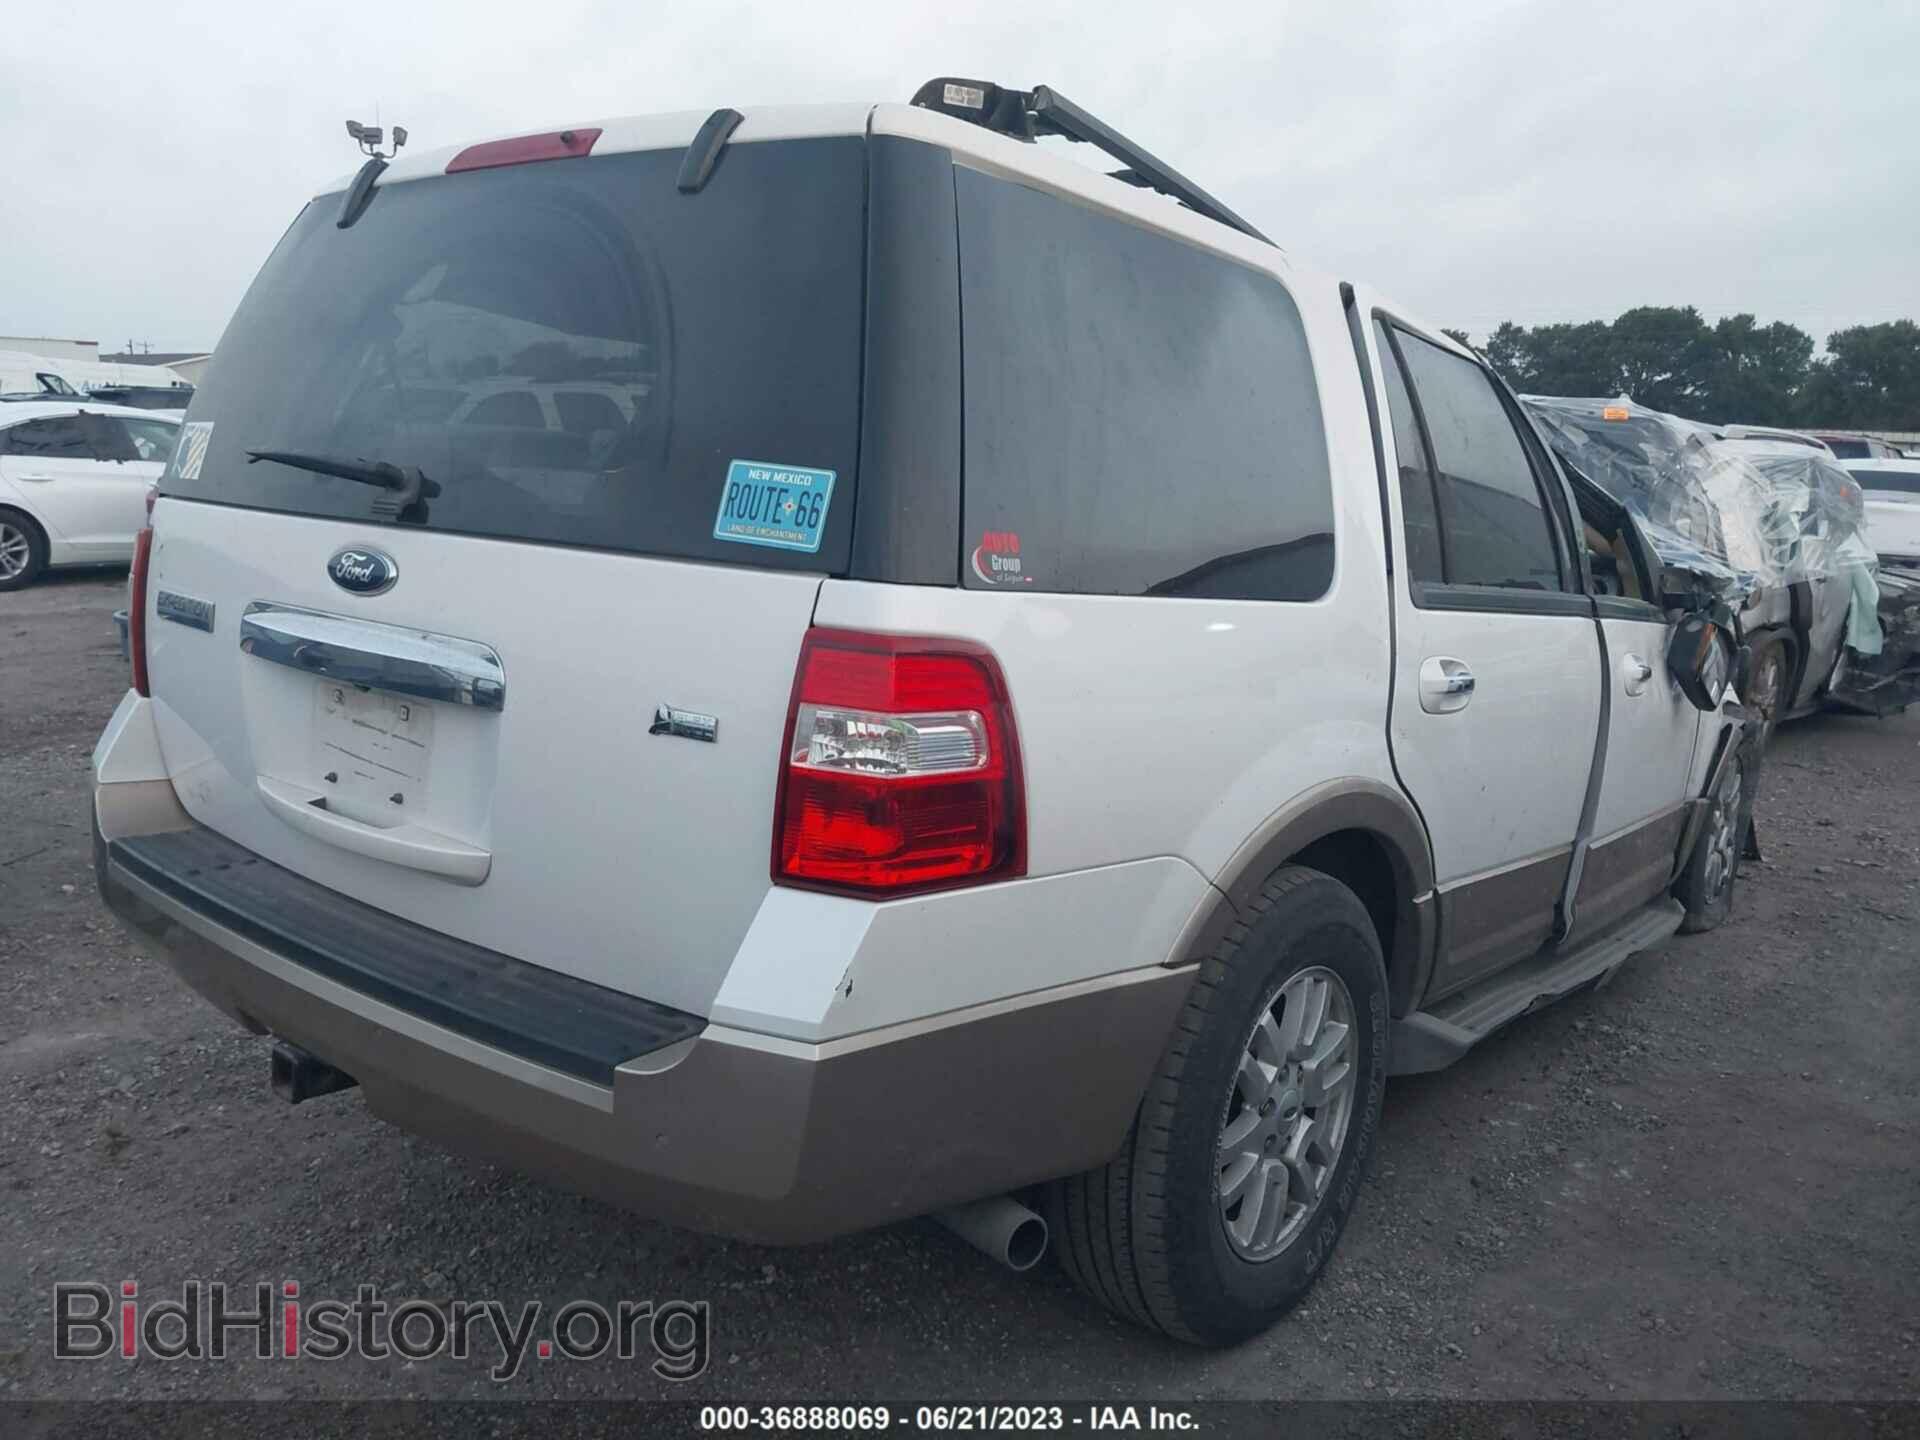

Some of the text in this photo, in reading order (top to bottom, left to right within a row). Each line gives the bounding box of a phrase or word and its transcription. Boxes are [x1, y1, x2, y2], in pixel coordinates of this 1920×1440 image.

[749, 470, 812, 486] NEW MEXICO
[724, 482, 824, 528] ROUTE 66
[336, 551, 375, 583] Ford
[992, 554, 1021, 574] Group
